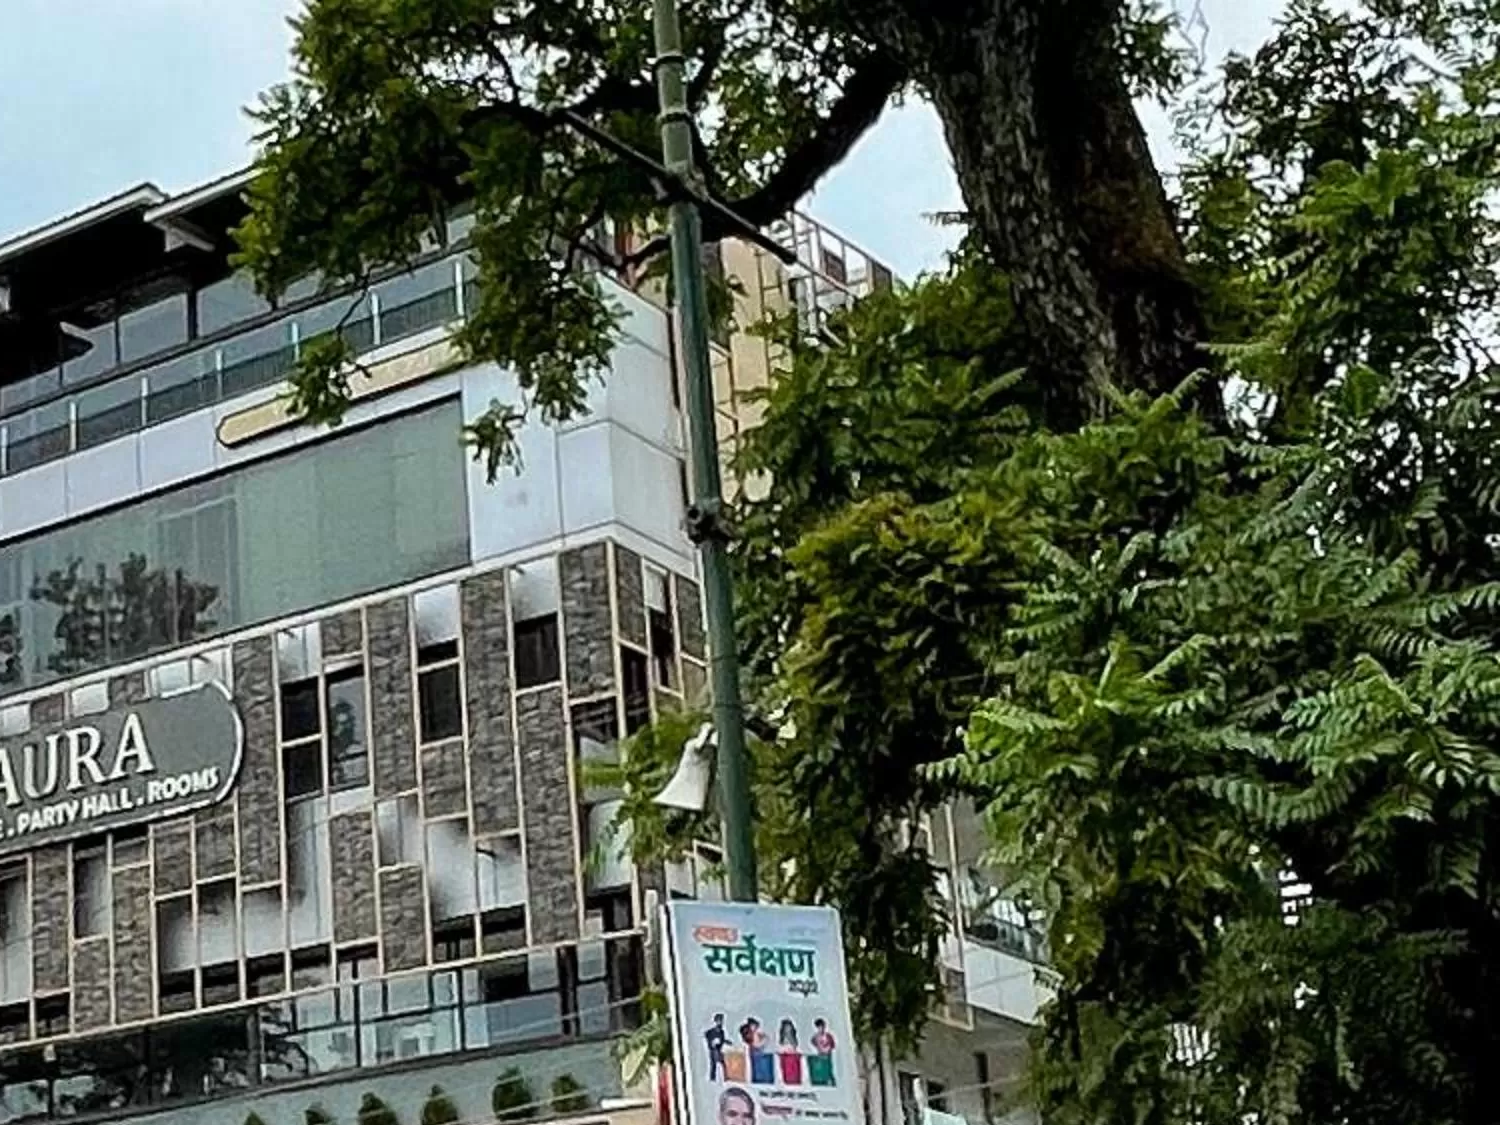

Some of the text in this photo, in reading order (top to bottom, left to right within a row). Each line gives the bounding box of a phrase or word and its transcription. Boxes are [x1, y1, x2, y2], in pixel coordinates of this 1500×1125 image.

[17, 800, 79, 833] PARTY
[81, 788, 134, 819] HALL
[148, 766, 220, 803] ROOMS
[702, 934, 816, 978] सर्वेक्षण
